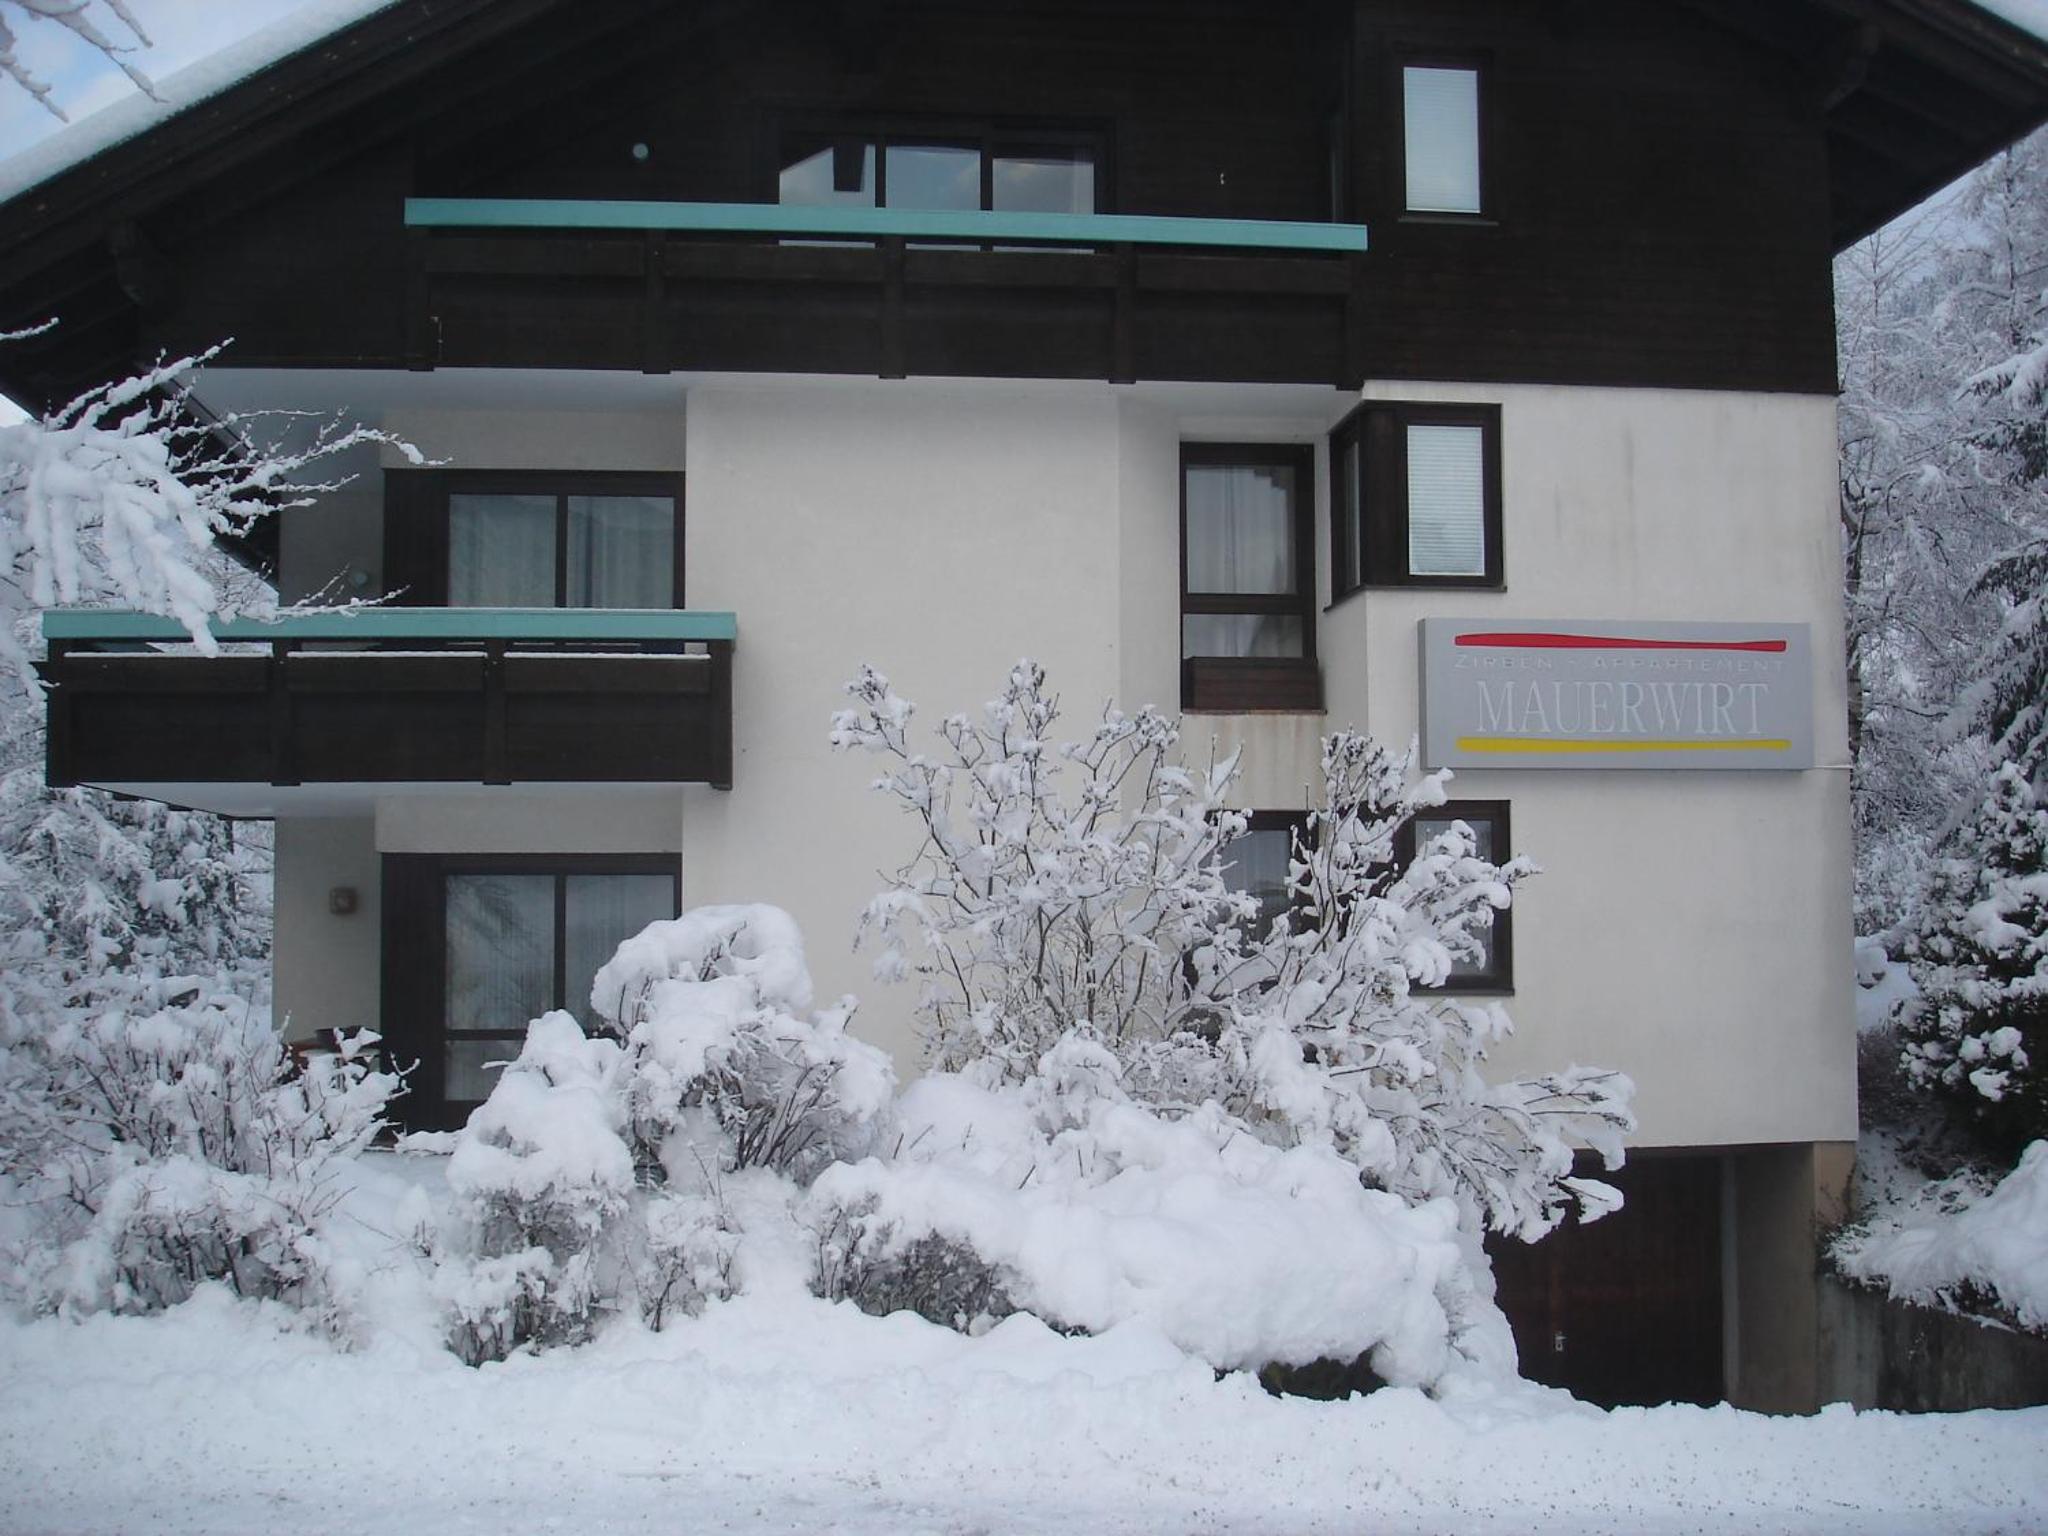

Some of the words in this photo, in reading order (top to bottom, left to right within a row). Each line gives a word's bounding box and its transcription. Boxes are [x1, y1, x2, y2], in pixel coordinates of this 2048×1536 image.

[1453, 653, 1552, 670] ZIRBEN
[1594, 655, 1785, 673] APPARTEMENT
[1476, 680, 1769, 735] MAUERWIRT
